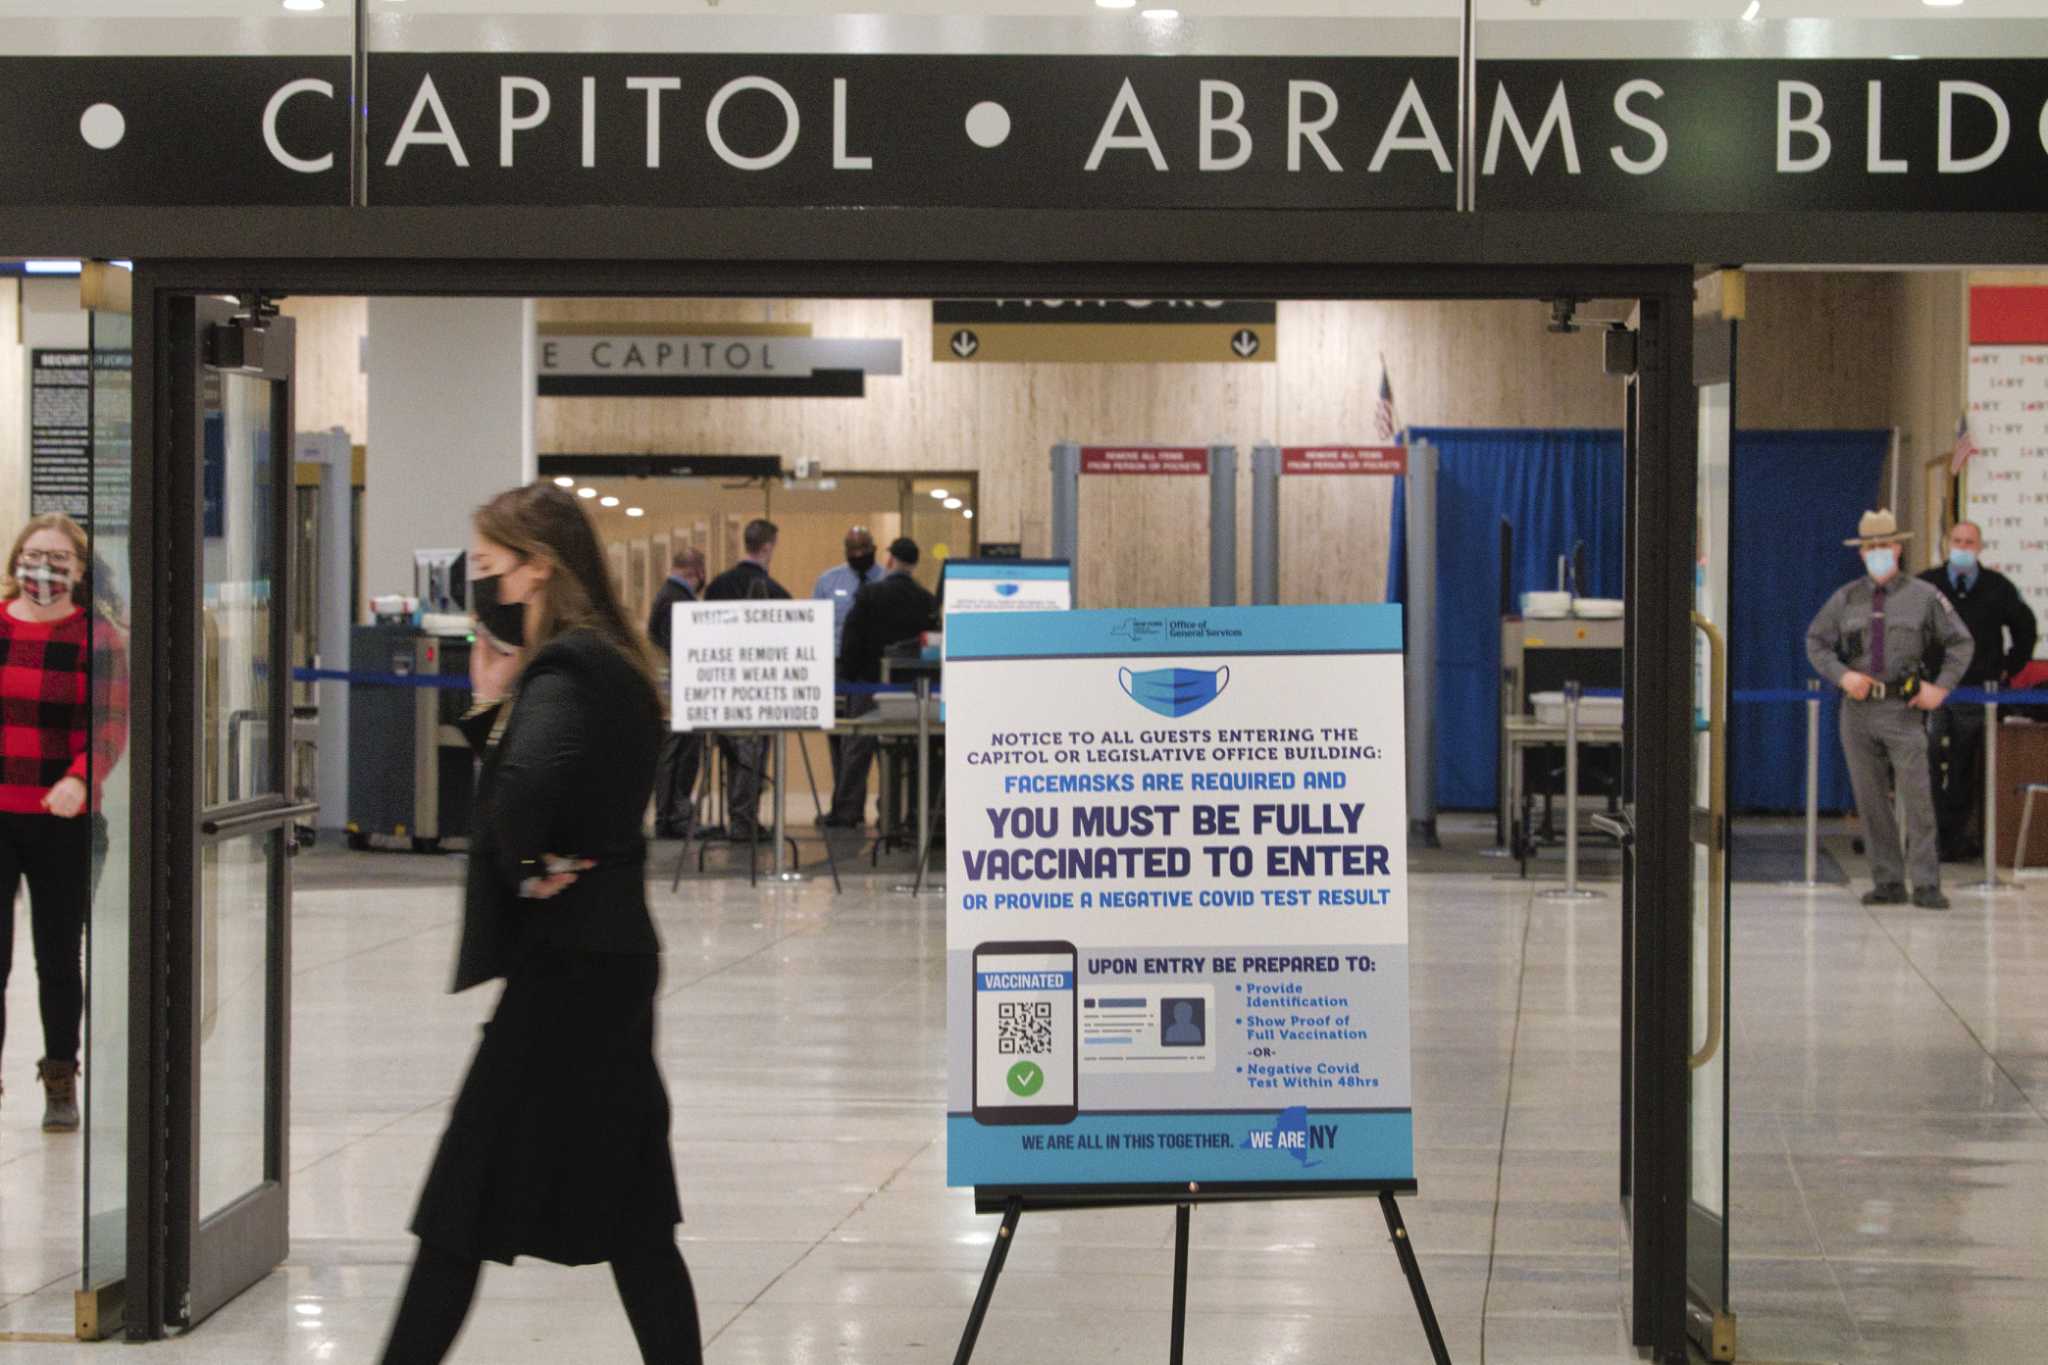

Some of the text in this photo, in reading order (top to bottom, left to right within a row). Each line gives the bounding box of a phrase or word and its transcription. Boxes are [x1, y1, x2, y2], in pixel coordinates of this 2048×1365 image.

[262, 73, 872, 173] CAPITOL
[1084, 77, 1669, 176] ABRAMS
[591, 342, 774, 369] CAPITOL
[744, 609, 815, 623] SCREENING
[1169, 620, 1193, 629] Office
[1195, 620, 1207, 628] of
[1169, 629, 1242, 637] General Services
[688, 646, 816, 662] PLEASE REMOVE ALL
[696, 667, 809, 682] OUTER WEAR AND
[685, 686, 821, 702] EMPTY POCKETS INTO
[687, 706, 819, 721] GREY BINS PROVIDED
[991, 728, 1358, 746] NOTICE TO ALL GUESTS ENTERING THE
[967, 746, 1382, 765] CAPITOL OR LEGISLATIVE OFFICE BUILDING:
[1004, 771, 1347, 793] FACEMASKS ARE REQUIRED AND
[986, 803, 1365, 839] YOU MUST BE FULLY
[962, 845, 1390, 881] VACCINATED TO ENTER
[962, 888, 1391, 910] OR PROVIDE A NEGATIVE COVID TEST RESULT
[1088, 956, 1376, 975] UPON ENTRY BE PREPARED TO:
[985, 973, 1064, 989] VACCINATED
[1247, 983, 1303, 994] Provide
[1246, 996, 1348, 1008] Identification
[1247, 1016, 1350, 1027] Show Proof of
[1247, 1029, 1367, 1040] Full Vaccination
[1248, 1047, 1276, 1057] -OR-
[1247, 1063, 1360, 1077] Negative Covid
[1248, 1076, 1379, 1088] Test Within 48hrs
[1022, 1133, 1234, 1150] WE ARE ALL IN THIS TOGETHER.
[1250, 1125, 1338, 1149] WE ARE NY
